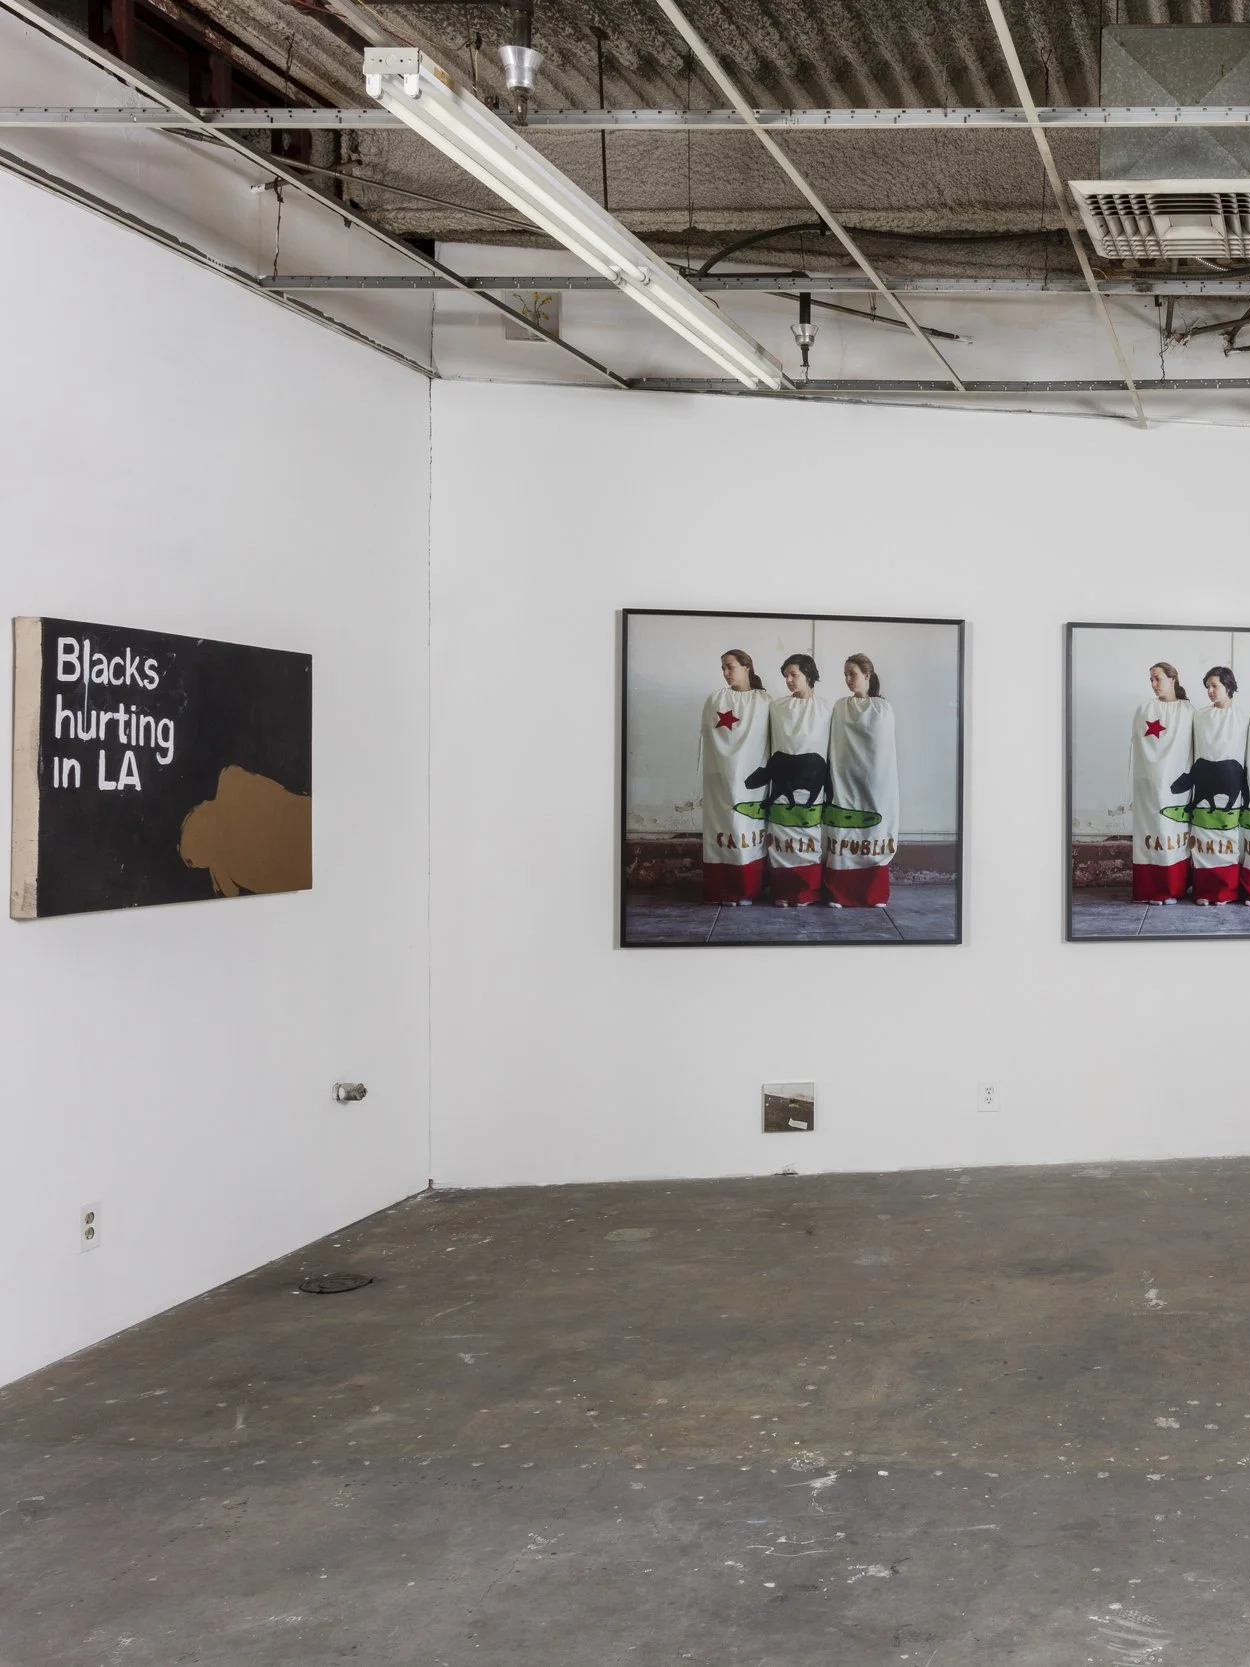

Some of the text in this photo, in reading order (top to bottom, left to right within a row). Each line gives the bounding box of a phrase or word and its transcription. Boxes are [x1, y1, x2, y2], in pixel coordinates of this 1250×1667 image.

[56, 637, 159, 690] Blacks
[54, 693, 175, 765] hurting
[53, 749, 142, 791] in LA
[716, 829, 815, 854] CALIFORNIA
[1144, 831, 1234, 855] CALIFORNIA
